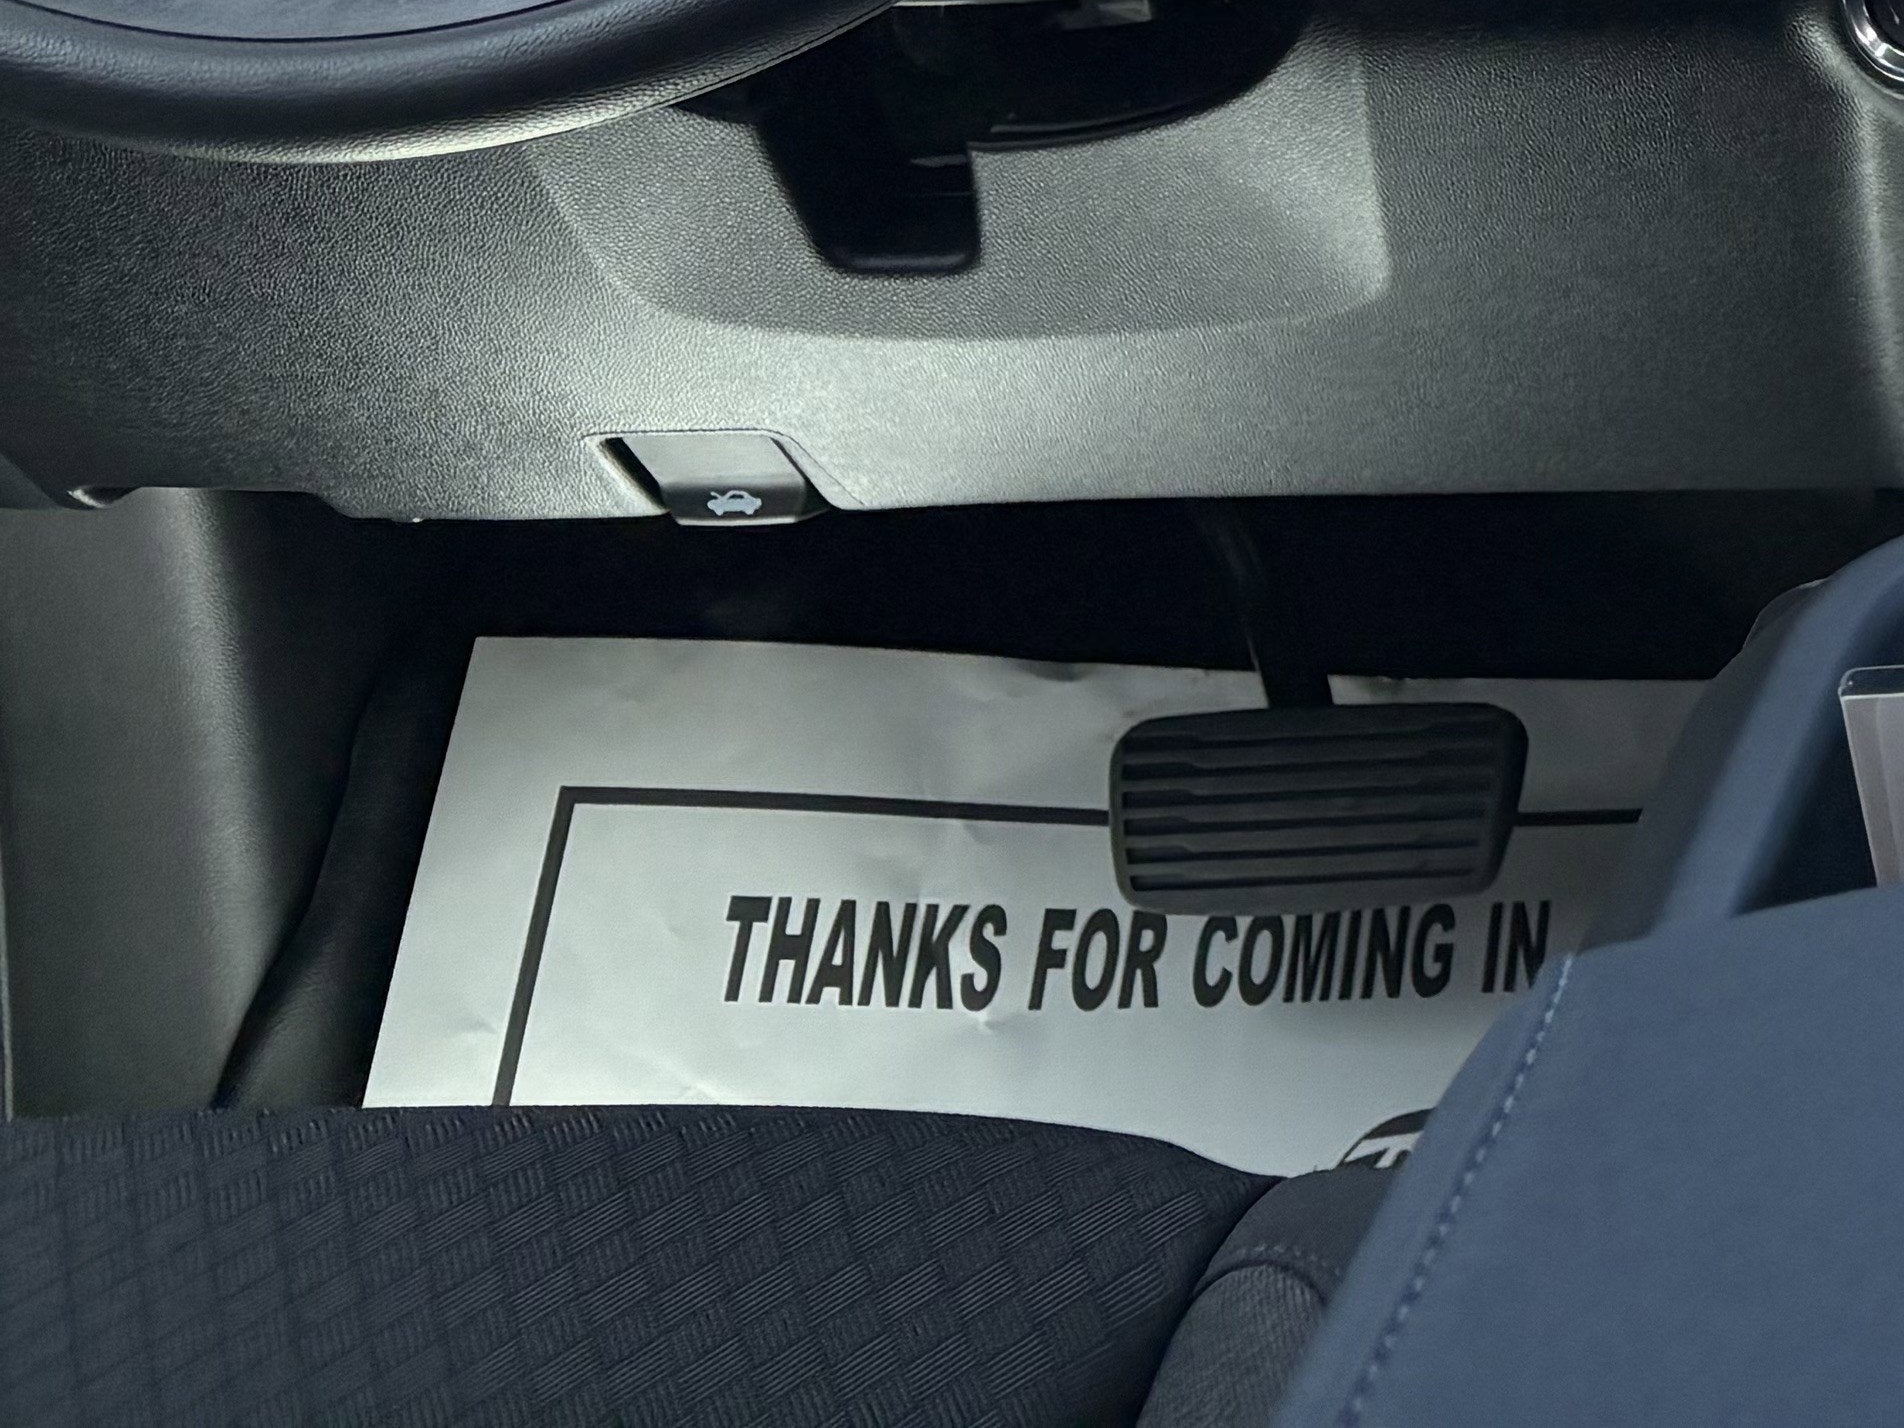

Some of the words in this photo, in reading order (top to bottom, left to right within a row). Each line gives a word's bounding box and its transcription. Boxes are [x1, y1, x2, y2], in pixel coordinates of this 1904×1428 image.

[724, 894, 1007, 1012] THANKS
[1028, 907, 1168, 1011] FOR
[1191, 906, 1456, 1008] COMING
[1481, 900, 1551, 995] IN
